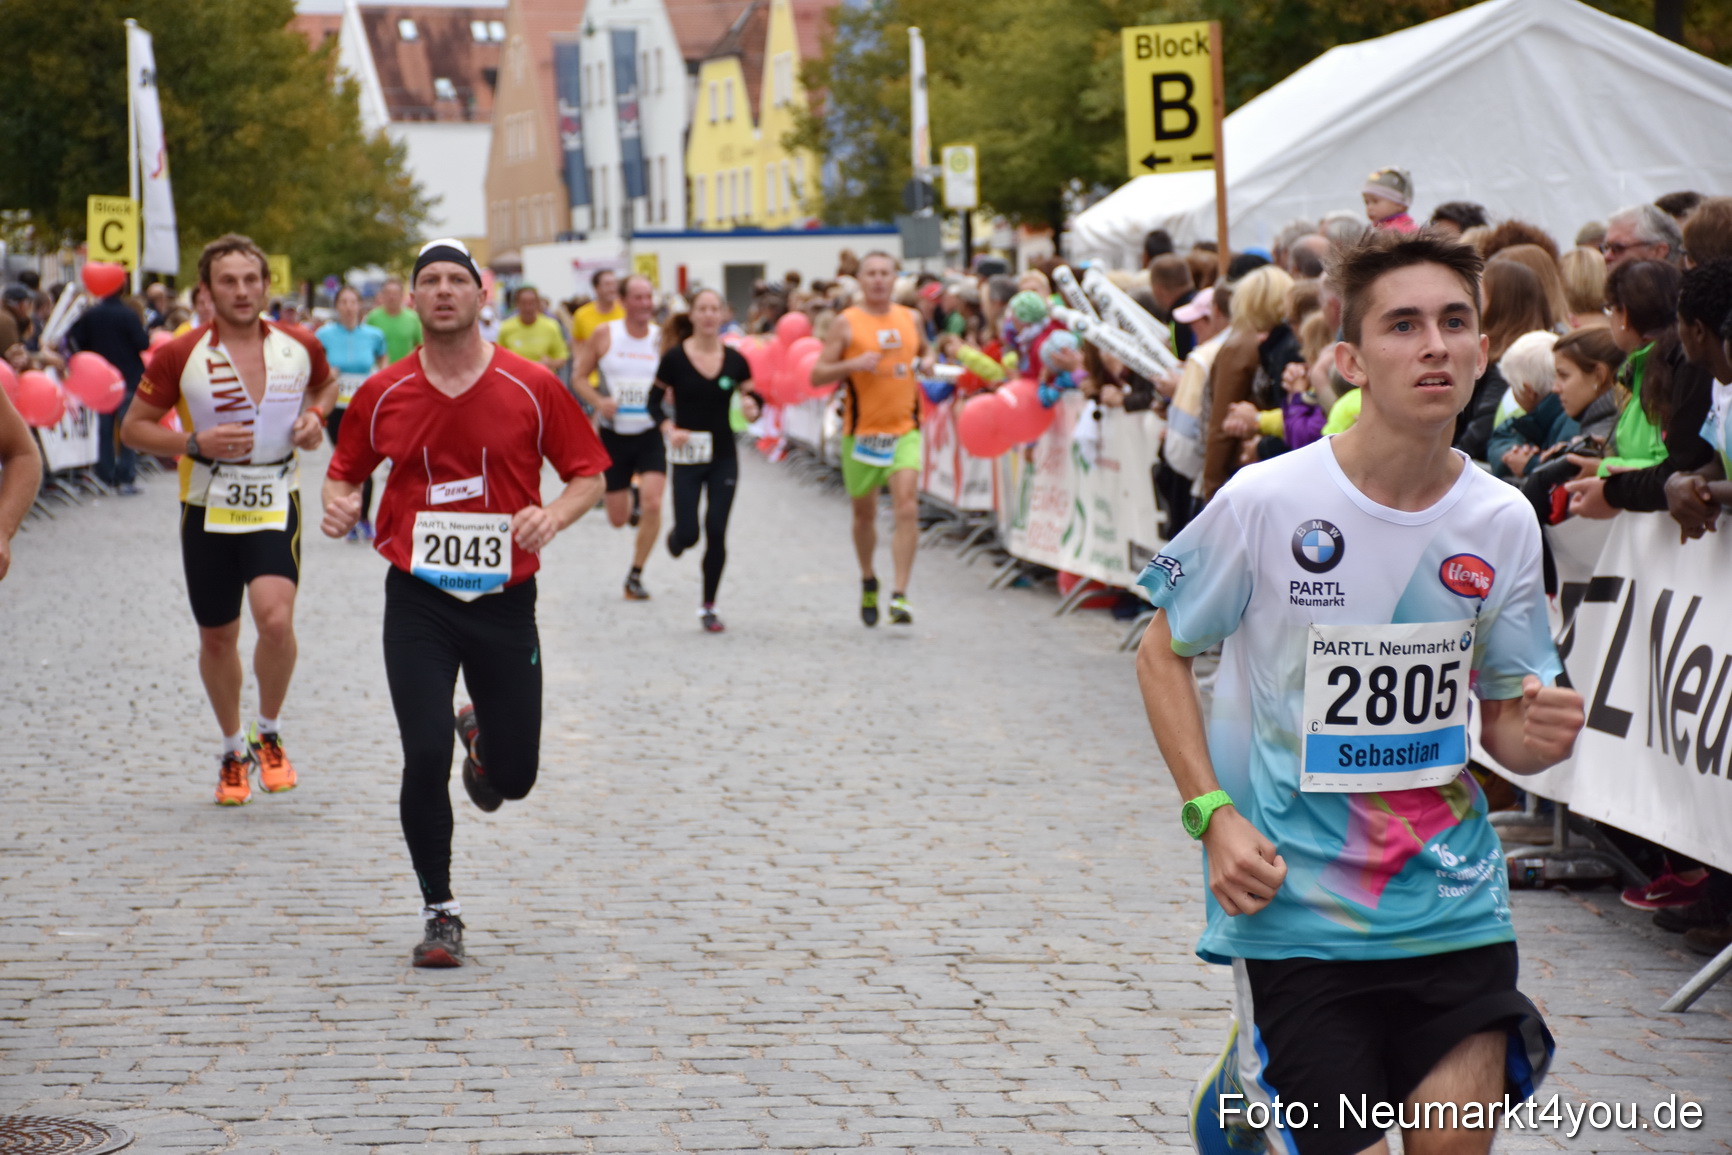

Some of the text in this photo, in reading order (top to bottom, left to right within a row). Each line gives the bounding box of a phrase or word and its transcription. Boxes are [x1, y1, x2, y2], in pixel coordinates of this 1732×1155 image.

[1136, 31, 1211, 60] Block
[1152, 72, 1199, 142] B
[94, 202, 132, 215] Block
[101, 219, 124, 255] C
[226, 483, 273, 508] 355
[444, 486, 469, 497] DEHN
[229, 511, 264, 525] Tobias
[416, 520, 496, 532] PARTL Neumarkt
[1296, 520, 1341, 539] BMW
[423, 533, 502, 568] 2043
[439, 575, 482, 590] Robert
[1289, 580, 1346, 597] PARTL
[1289, 594, 1346, 607] Neumarkt
[1312, 638, 1456, 657] PARTL Neumarkt
[1325, 660, 1461, 727] 2805
[1646, 587, 1732, 782] Neu
[1310, 721, 1319, 733] C
[1337, 741, 1440, 767] Sebastian
